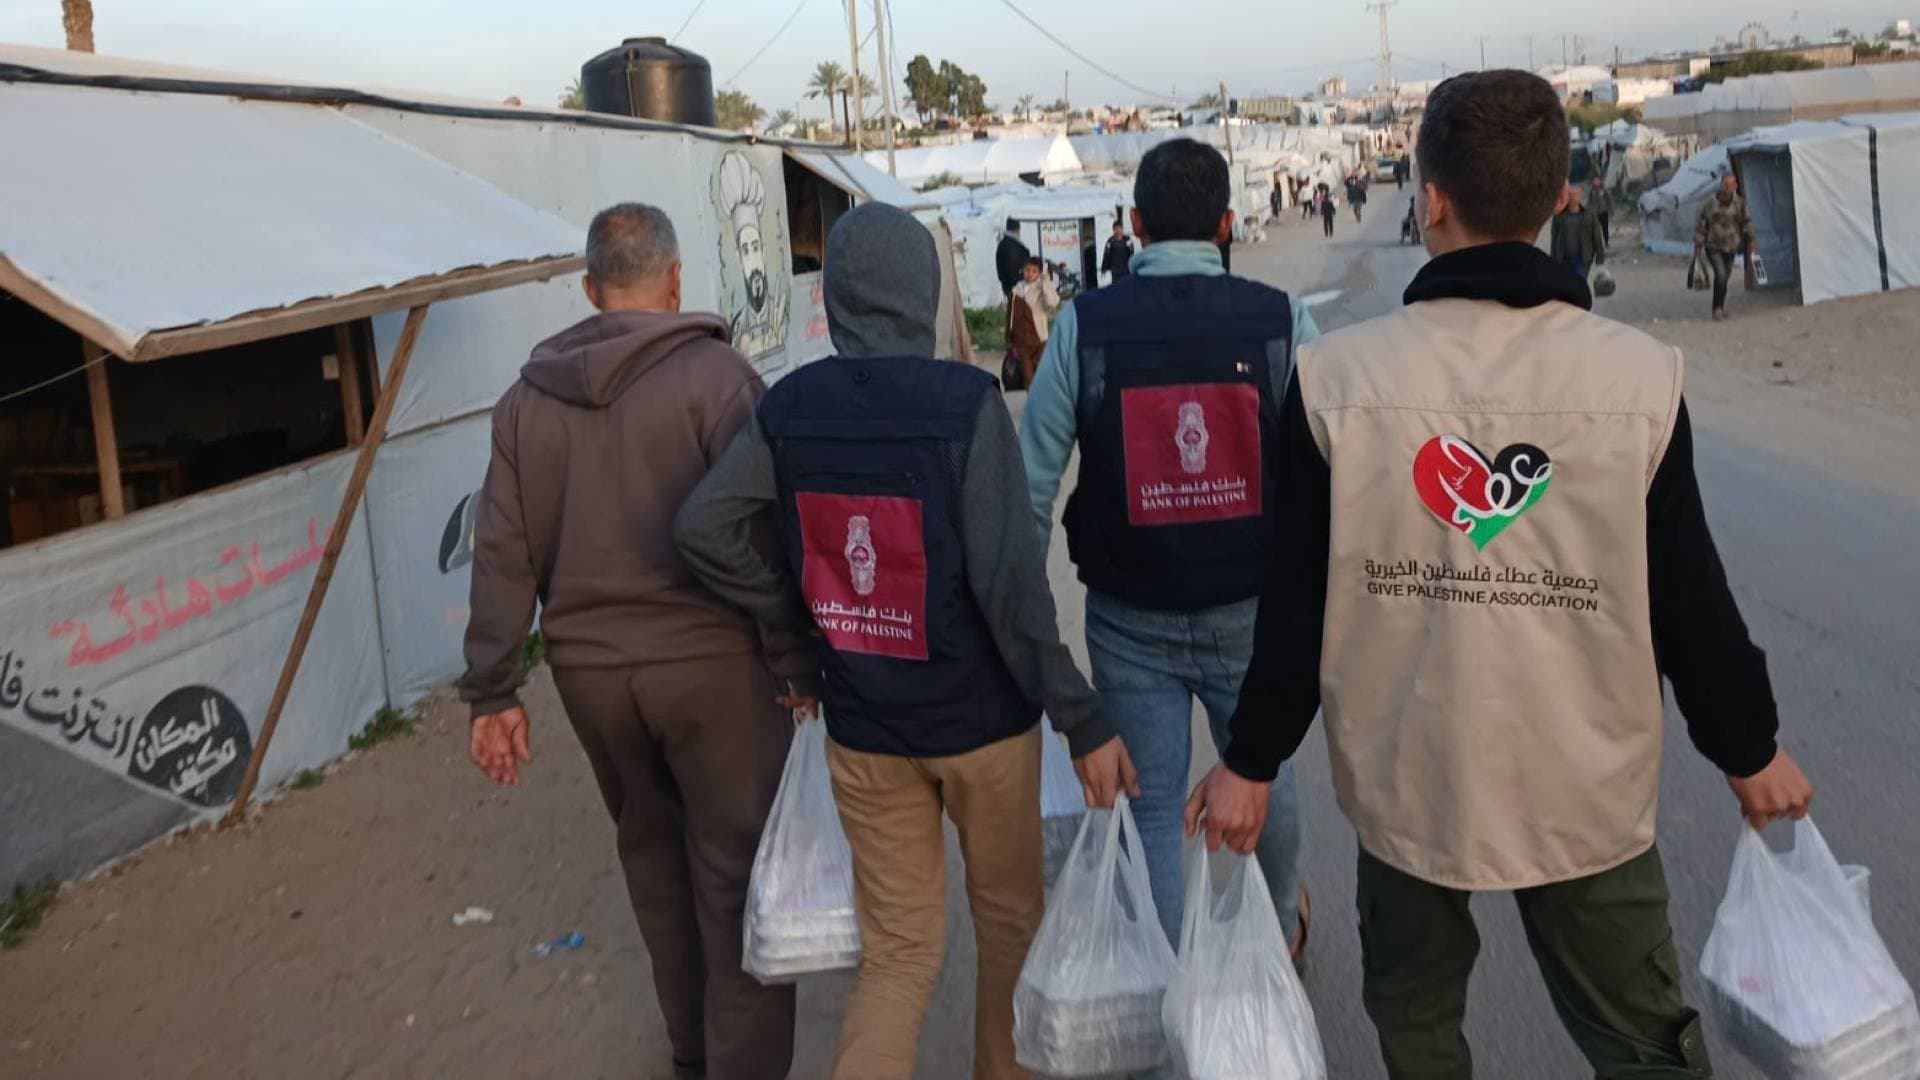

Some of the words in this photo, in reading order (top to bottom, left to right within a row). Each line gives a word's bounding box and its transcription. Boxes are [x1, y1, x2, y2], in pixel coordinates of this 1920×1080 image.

[1140, 480, 1210, 497] فلسطين
[1211, 475, 1247, 490] بنك
[1141, 497, 1173, 511] BANK
[1175, 496, 1190, 508] OF
[1193, 490, 1247, 506] PALESTINE
[215, 516, 337, 603] لسات
[1365, 560, 1418, 580] الخيرية
[1423, 563, 1491, 582] فلسطين
[1495, 567, 1538, 584] عطاء
[1542, 569, 1599, 594] جمعية
[1367, 583, 1404, 597] GIVE
[1407, 584, 1486, 604] PALESTINE
[1489, 591, 1598, 612] ASSOCIATION
[812, 598, 877, 618] فلسطين
[879, 608, 912, 625] بنك
[841, 621, 858, 633] OF
[861, 622, 913, 641] PALESTINE
[136, 696, 220, 773] المكان
